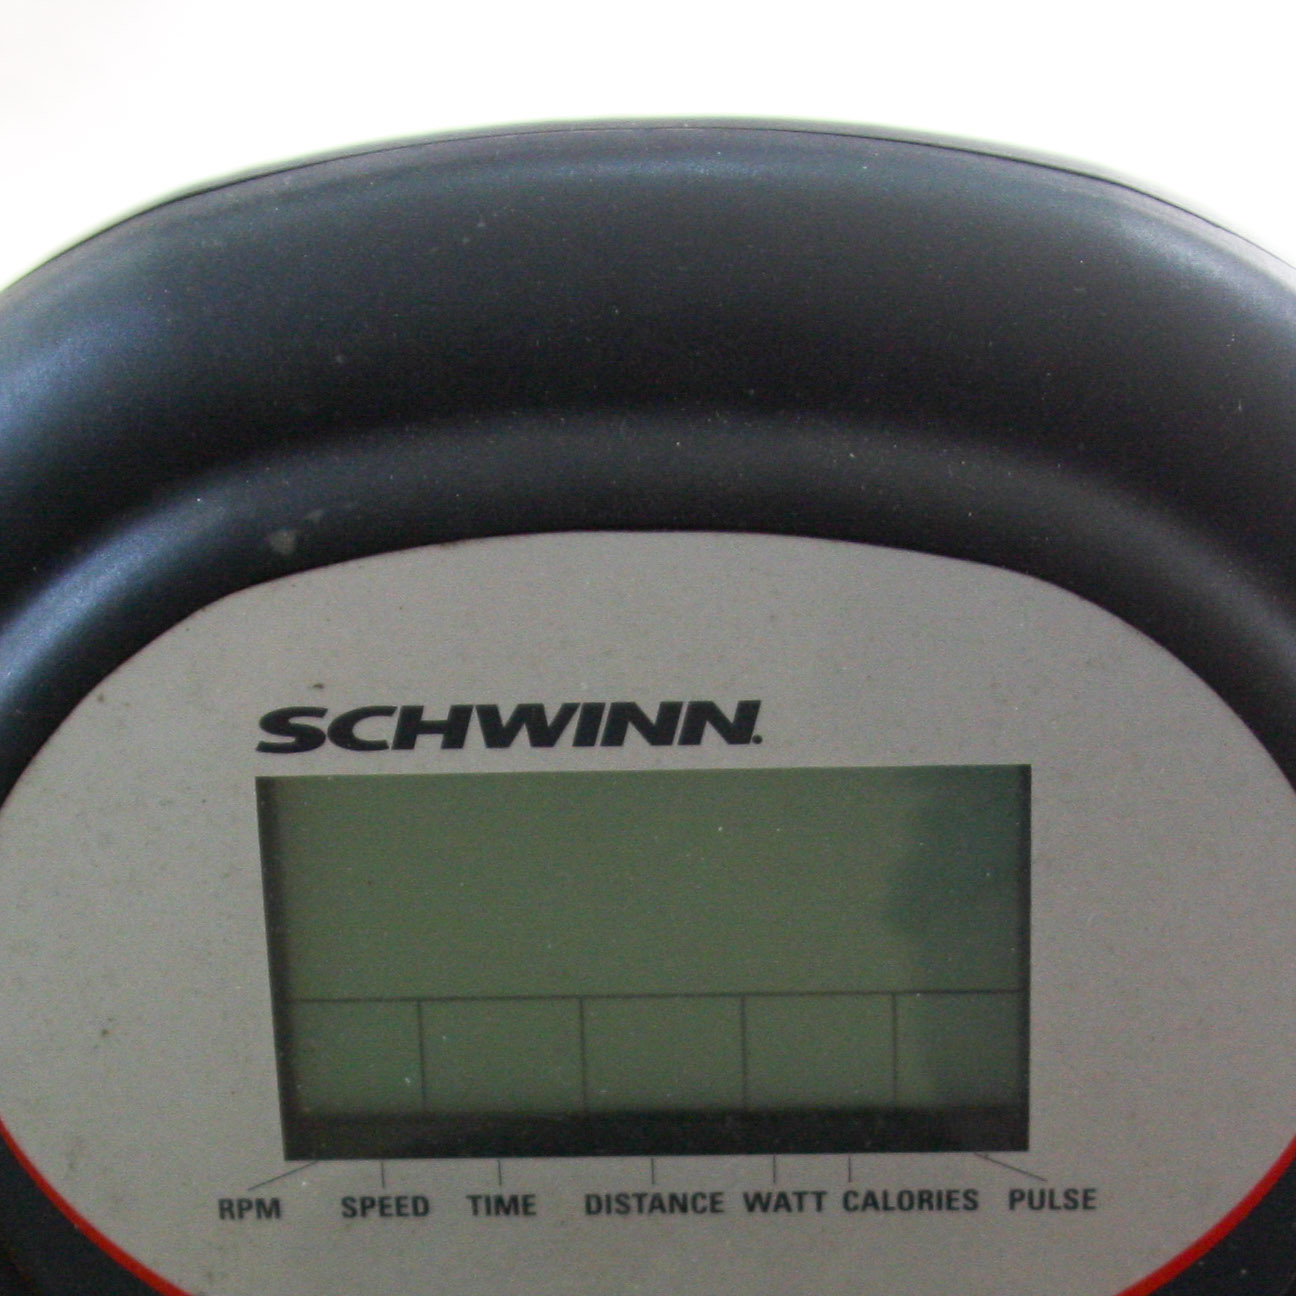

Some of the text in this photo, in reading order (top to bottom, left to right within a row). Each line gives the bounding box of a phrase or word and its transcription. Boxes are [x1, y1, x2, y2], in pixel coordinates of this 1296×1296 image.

[218, 1198, 282, 1220] RPM
[341, 1195, 431, 1218] SPEED
[466, 1194, 538, 1217] TIME
[585, 1191, 725, 1215] DISTANCE
[743, 1190, 829, 1214] WATT
[842, 1189, 980, 1212] CALORIES
[1008, 1187, 1098, 1211] PULSE
